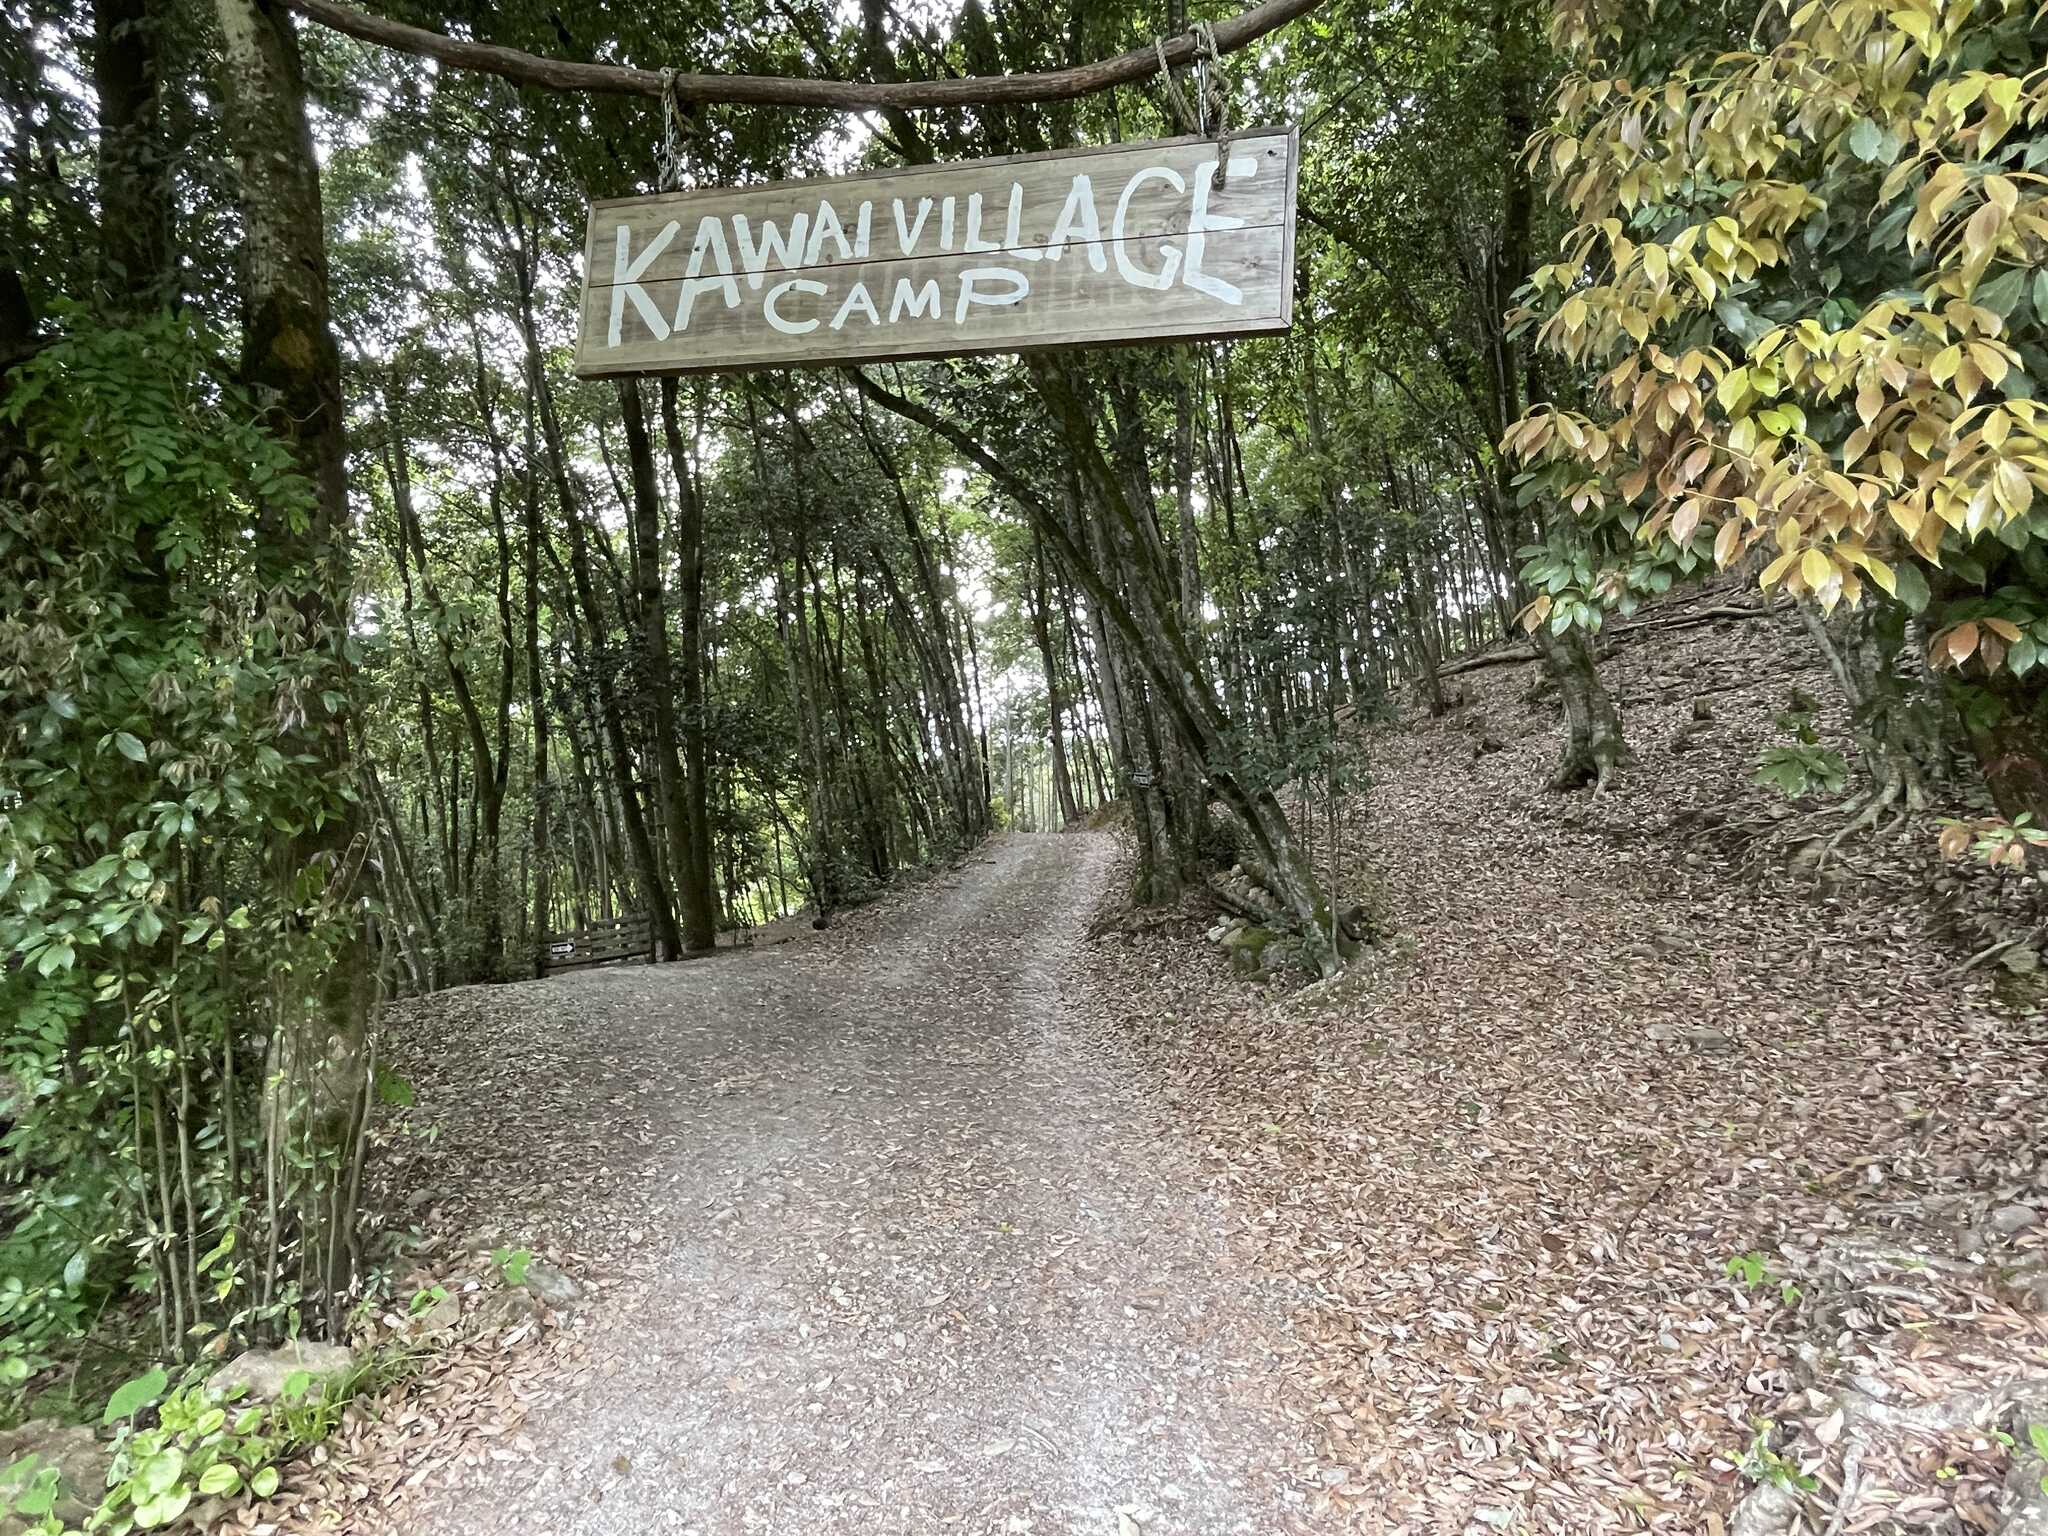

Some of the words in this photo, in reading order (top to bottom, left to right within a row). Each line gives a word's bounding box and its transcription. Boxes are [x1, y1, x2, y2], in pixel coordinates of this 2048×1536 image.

[608, 201, 873, 346] KAWAI
[893, 158, 1258, 304] VILLAGE
[764, 267, 1030, 334] CAMP
